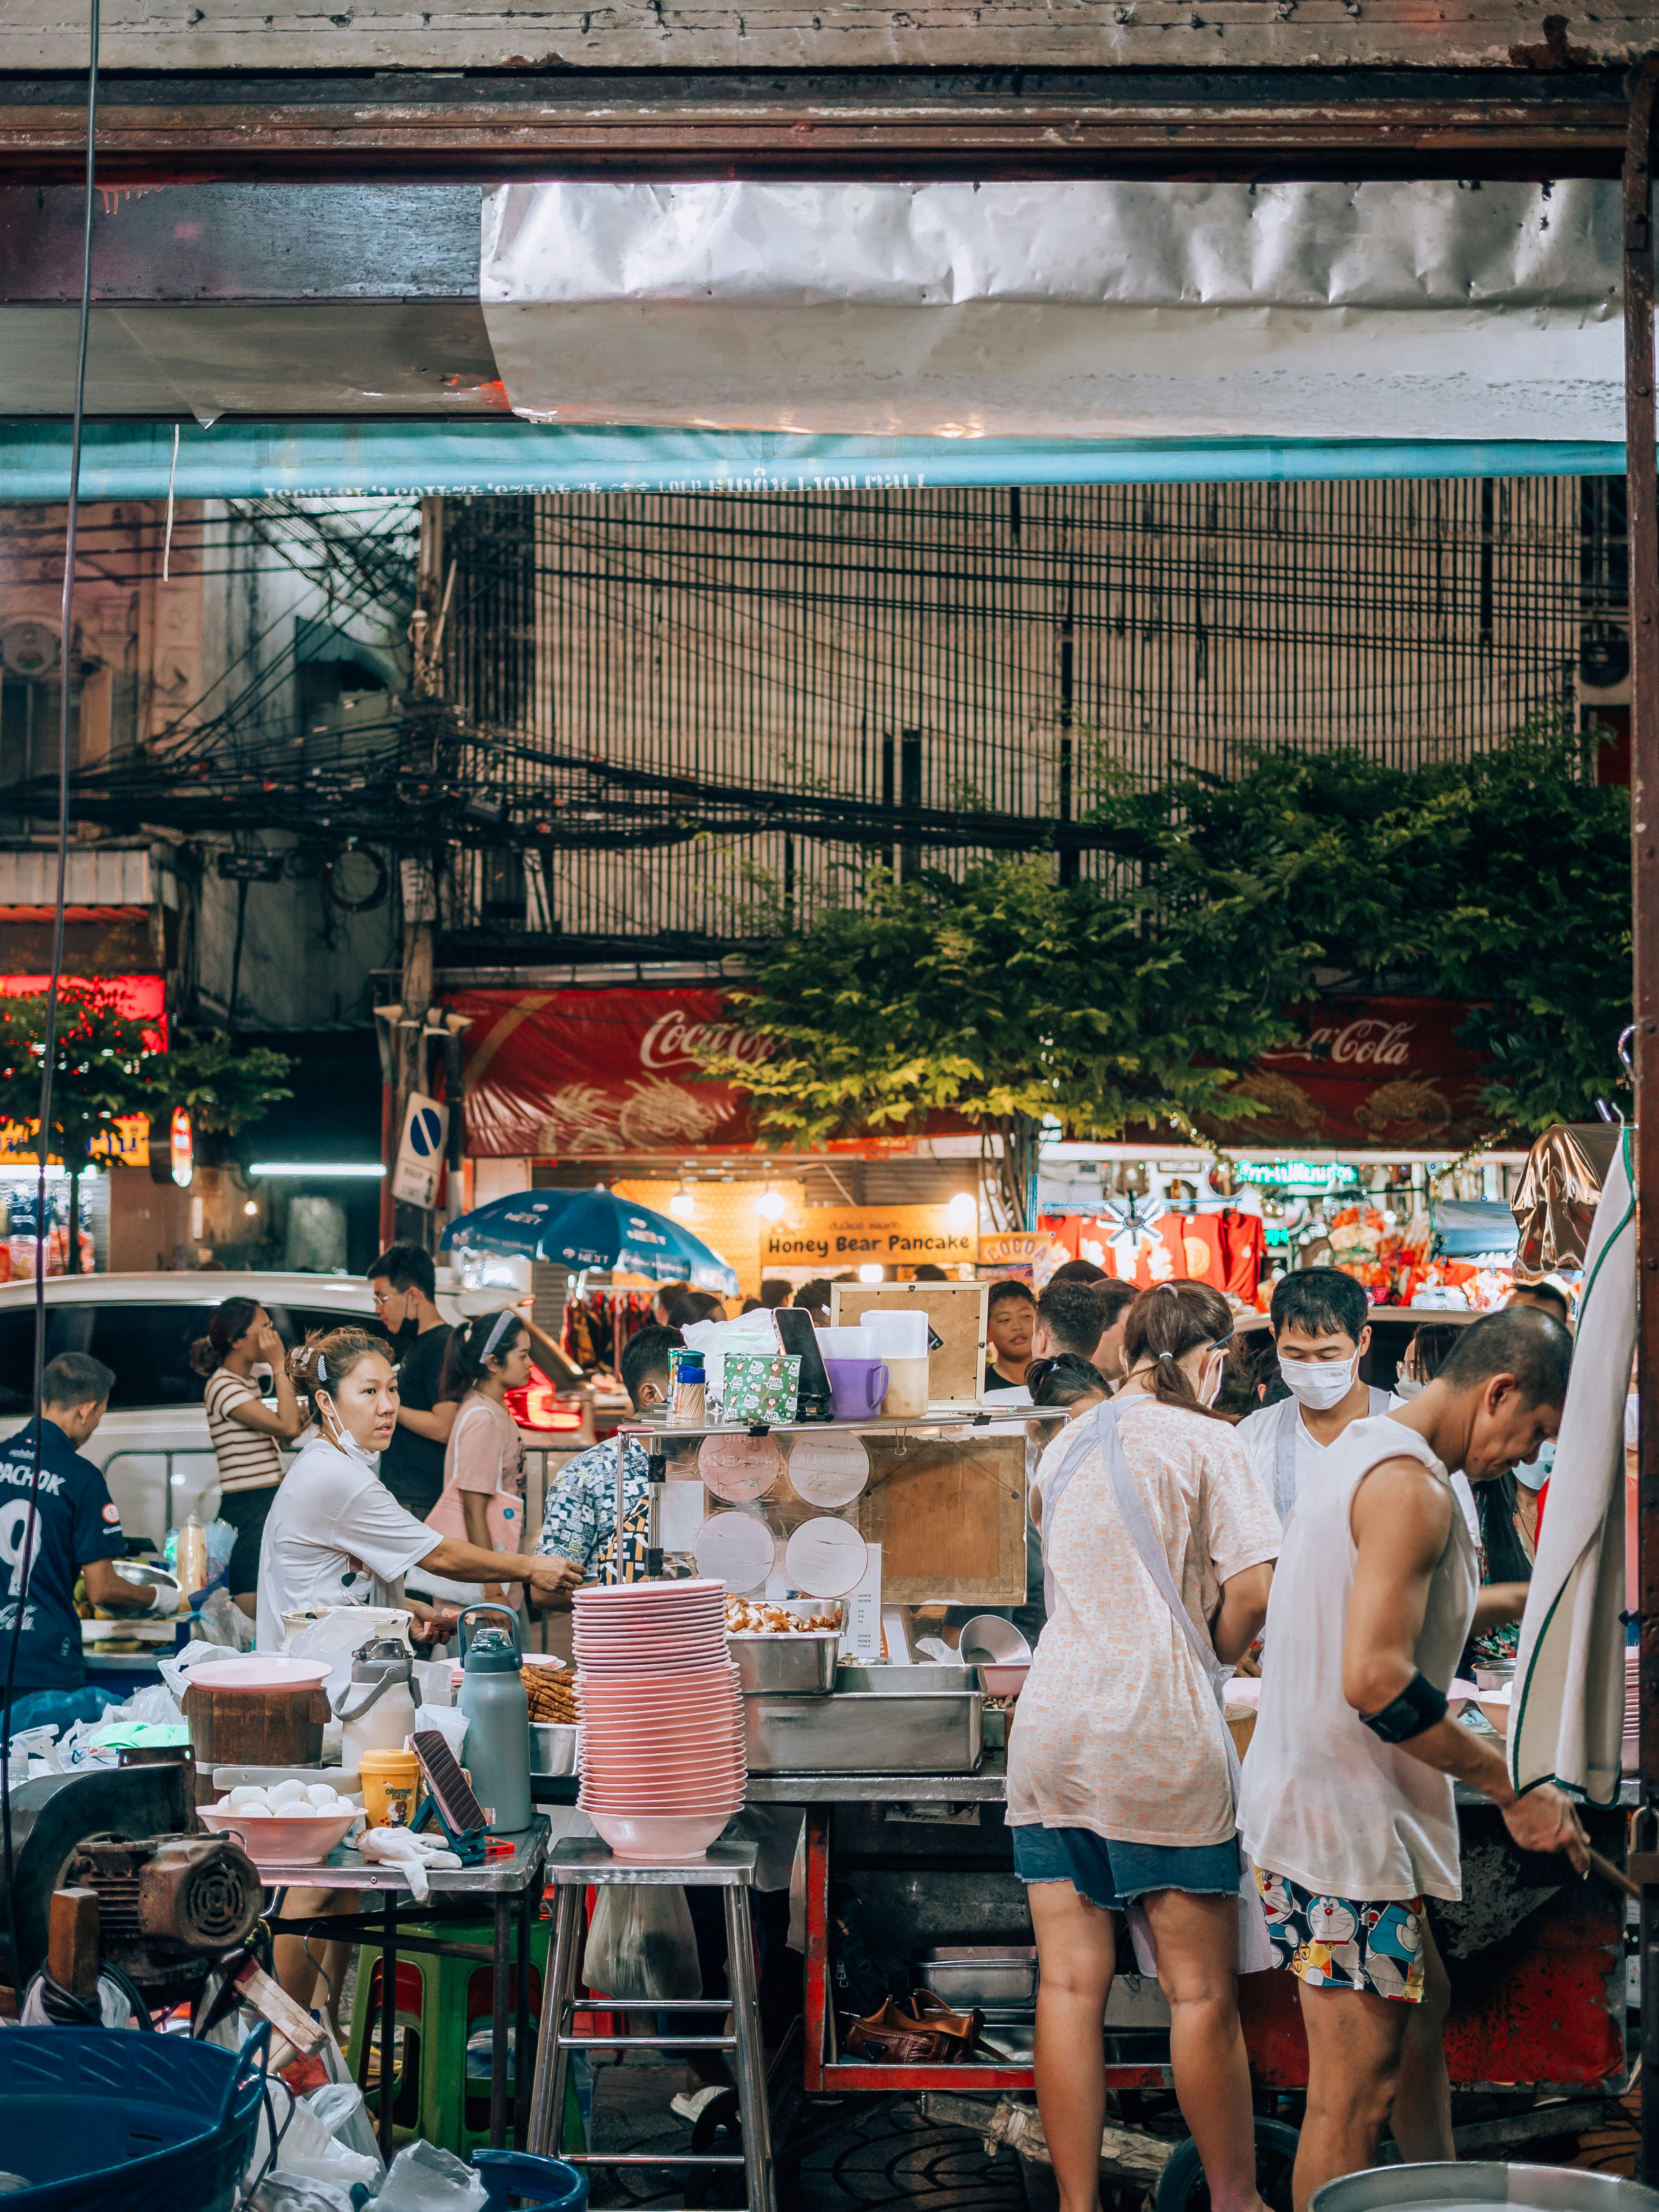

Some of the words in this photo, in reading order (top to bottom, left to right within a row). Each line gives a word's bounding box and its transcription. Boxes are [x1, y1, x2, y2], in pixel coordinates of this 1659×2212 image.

[769, 1238, 828, 1257] Honey
[836, 1236, 881, 1252] Bear
[888, 1235, 970, 1251] Pancake
[984, 1238, 1046, 1263] COCOA
[0, 1499, 42, 1598] 9
